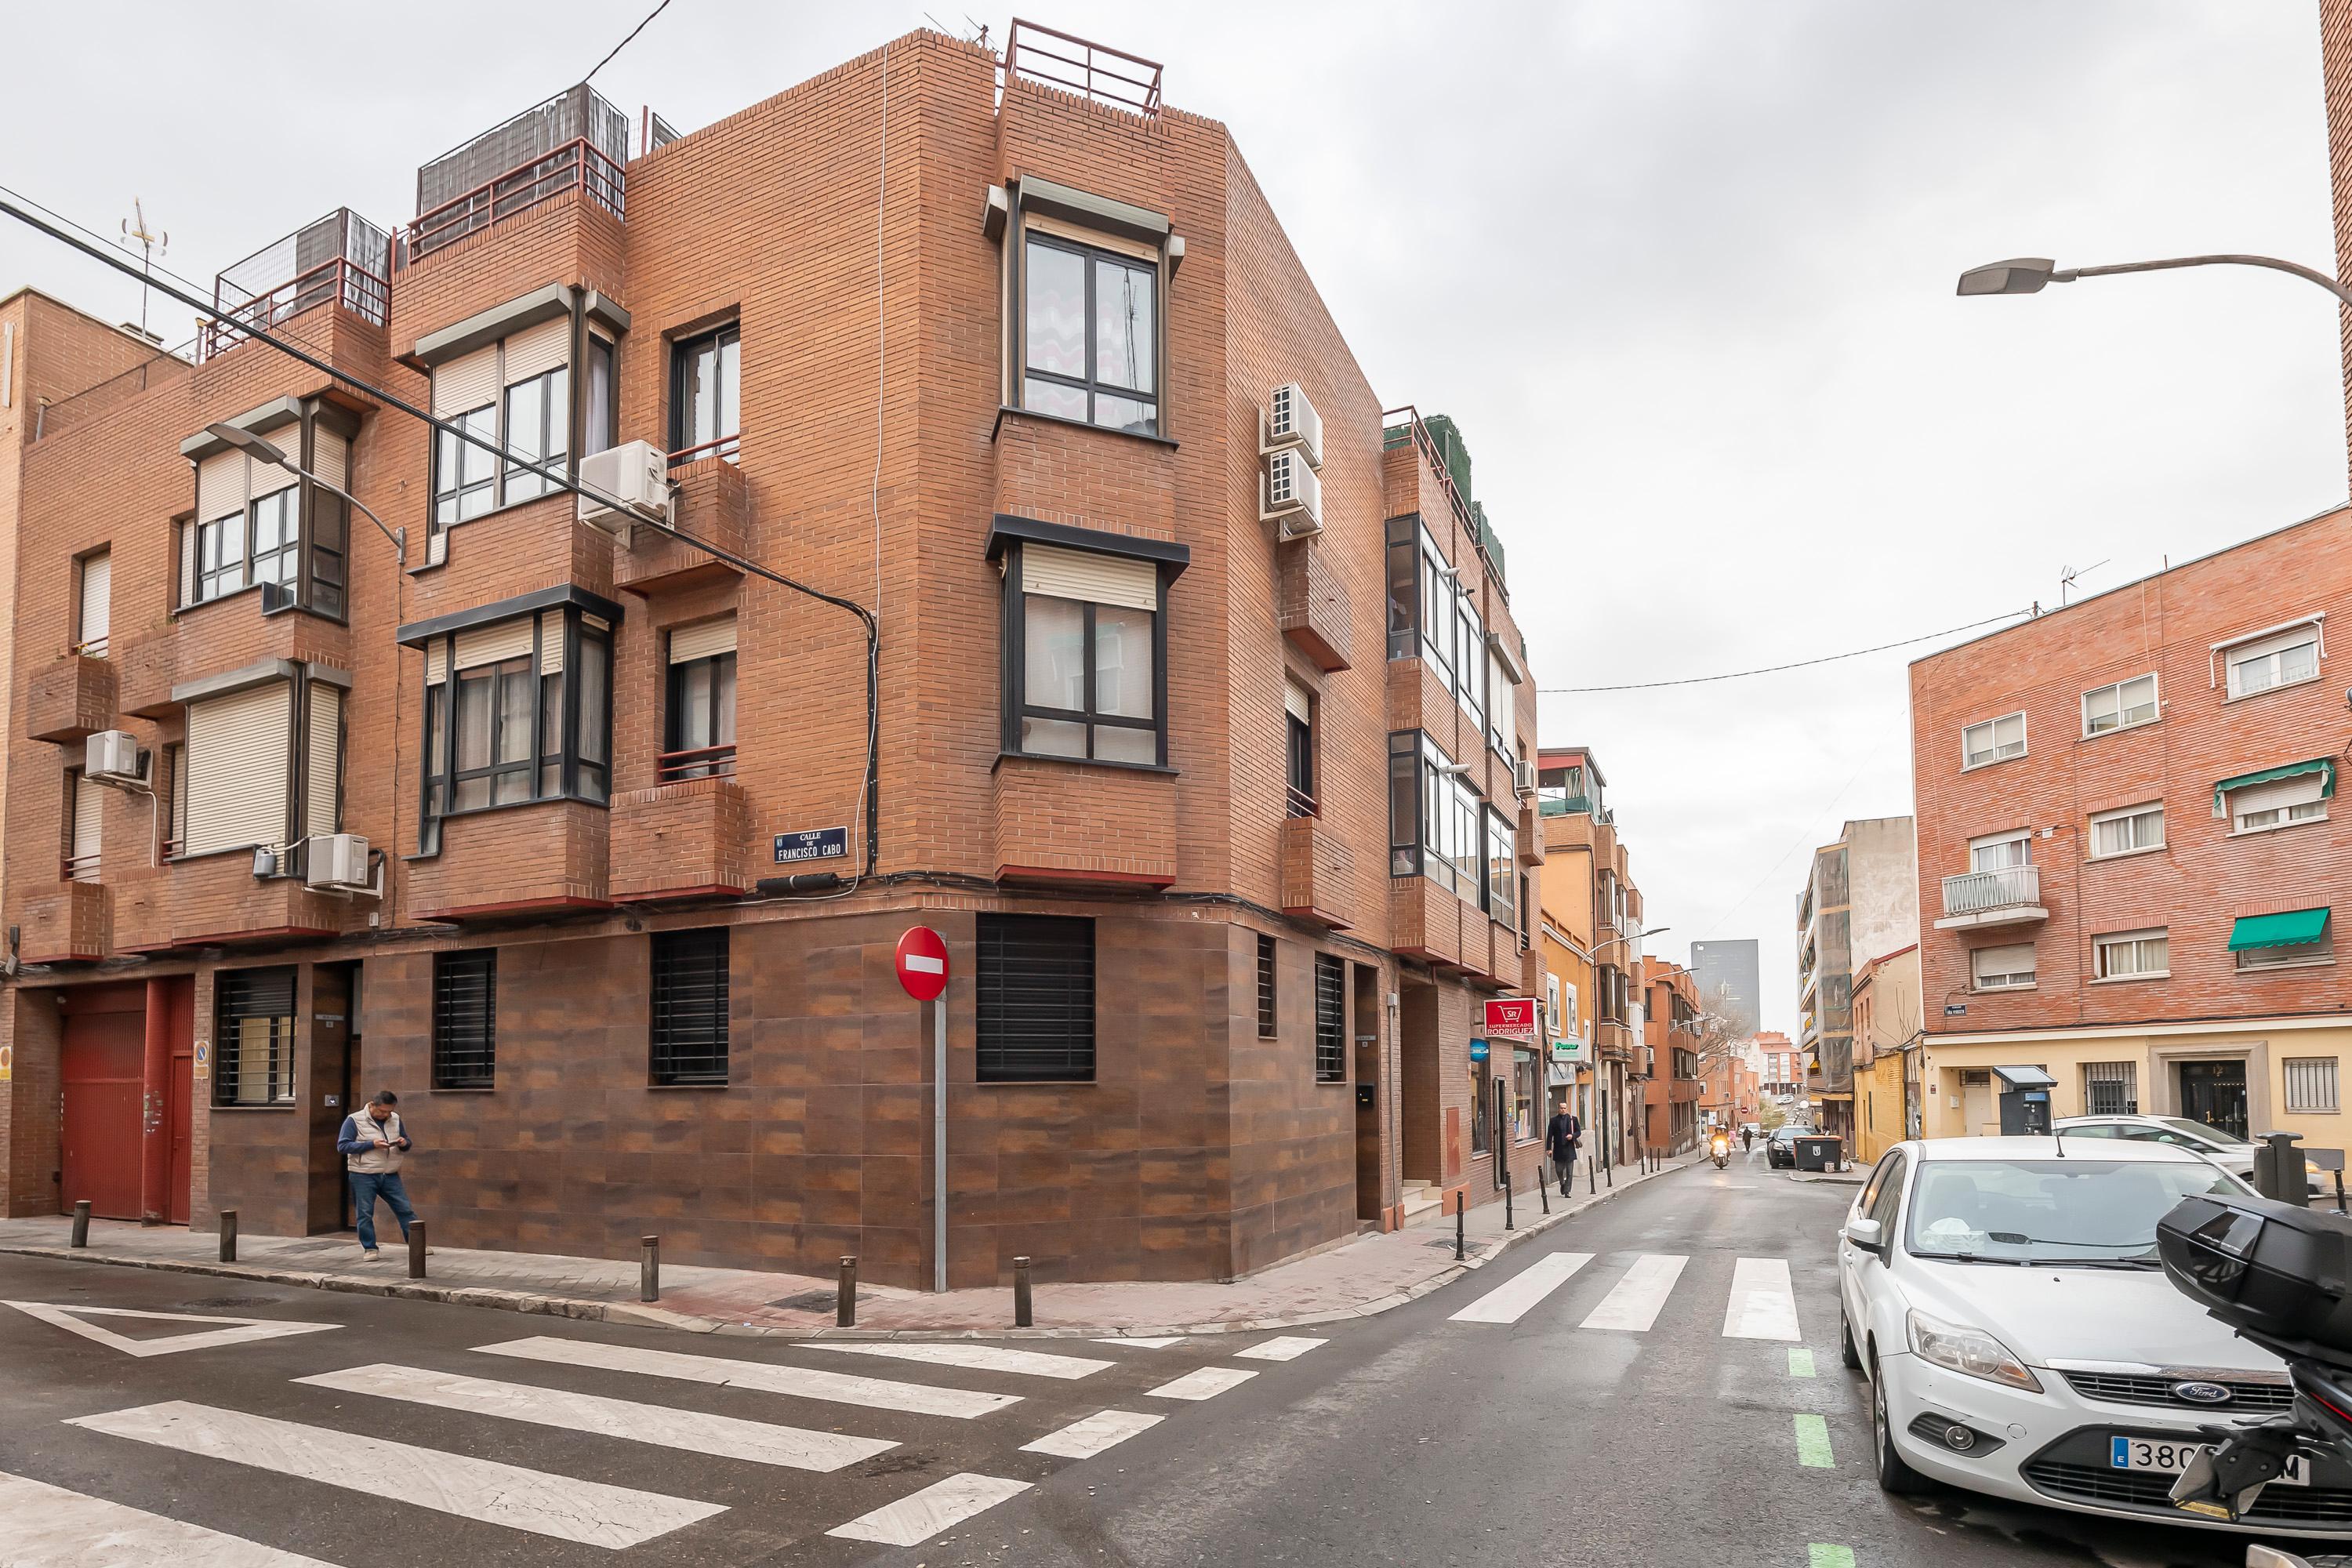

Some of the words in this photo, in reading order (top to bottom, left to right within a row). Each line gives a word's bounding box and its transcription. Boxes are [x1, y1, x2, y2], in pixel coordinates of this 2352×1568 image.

[779, 847, 817, 860] FRANCISCO
[822, 844, 840, 855] CABO
[2190, 1386, 2217, 1397] Ford
[2135, 1443, 2196, 1469] 380
